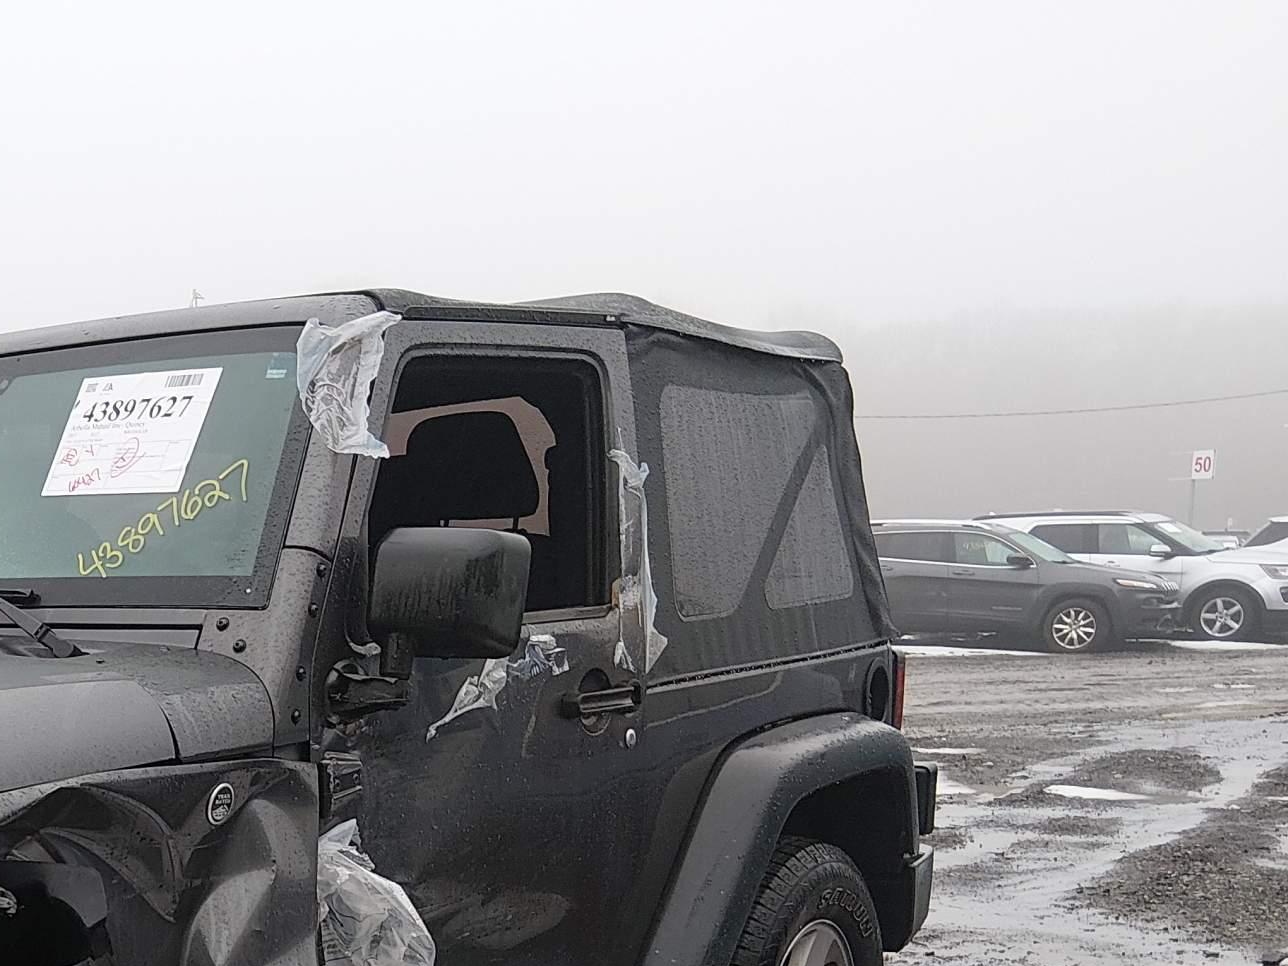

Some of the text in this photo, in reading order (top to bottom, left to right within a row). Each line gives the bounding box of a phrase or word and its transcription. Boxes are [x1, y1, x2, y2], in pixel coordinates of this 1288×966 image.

[83, 396, 194, 422] 43897627
[1194, 456, 1212, 473] 50
[76, 459, 249, 578] 43897627
